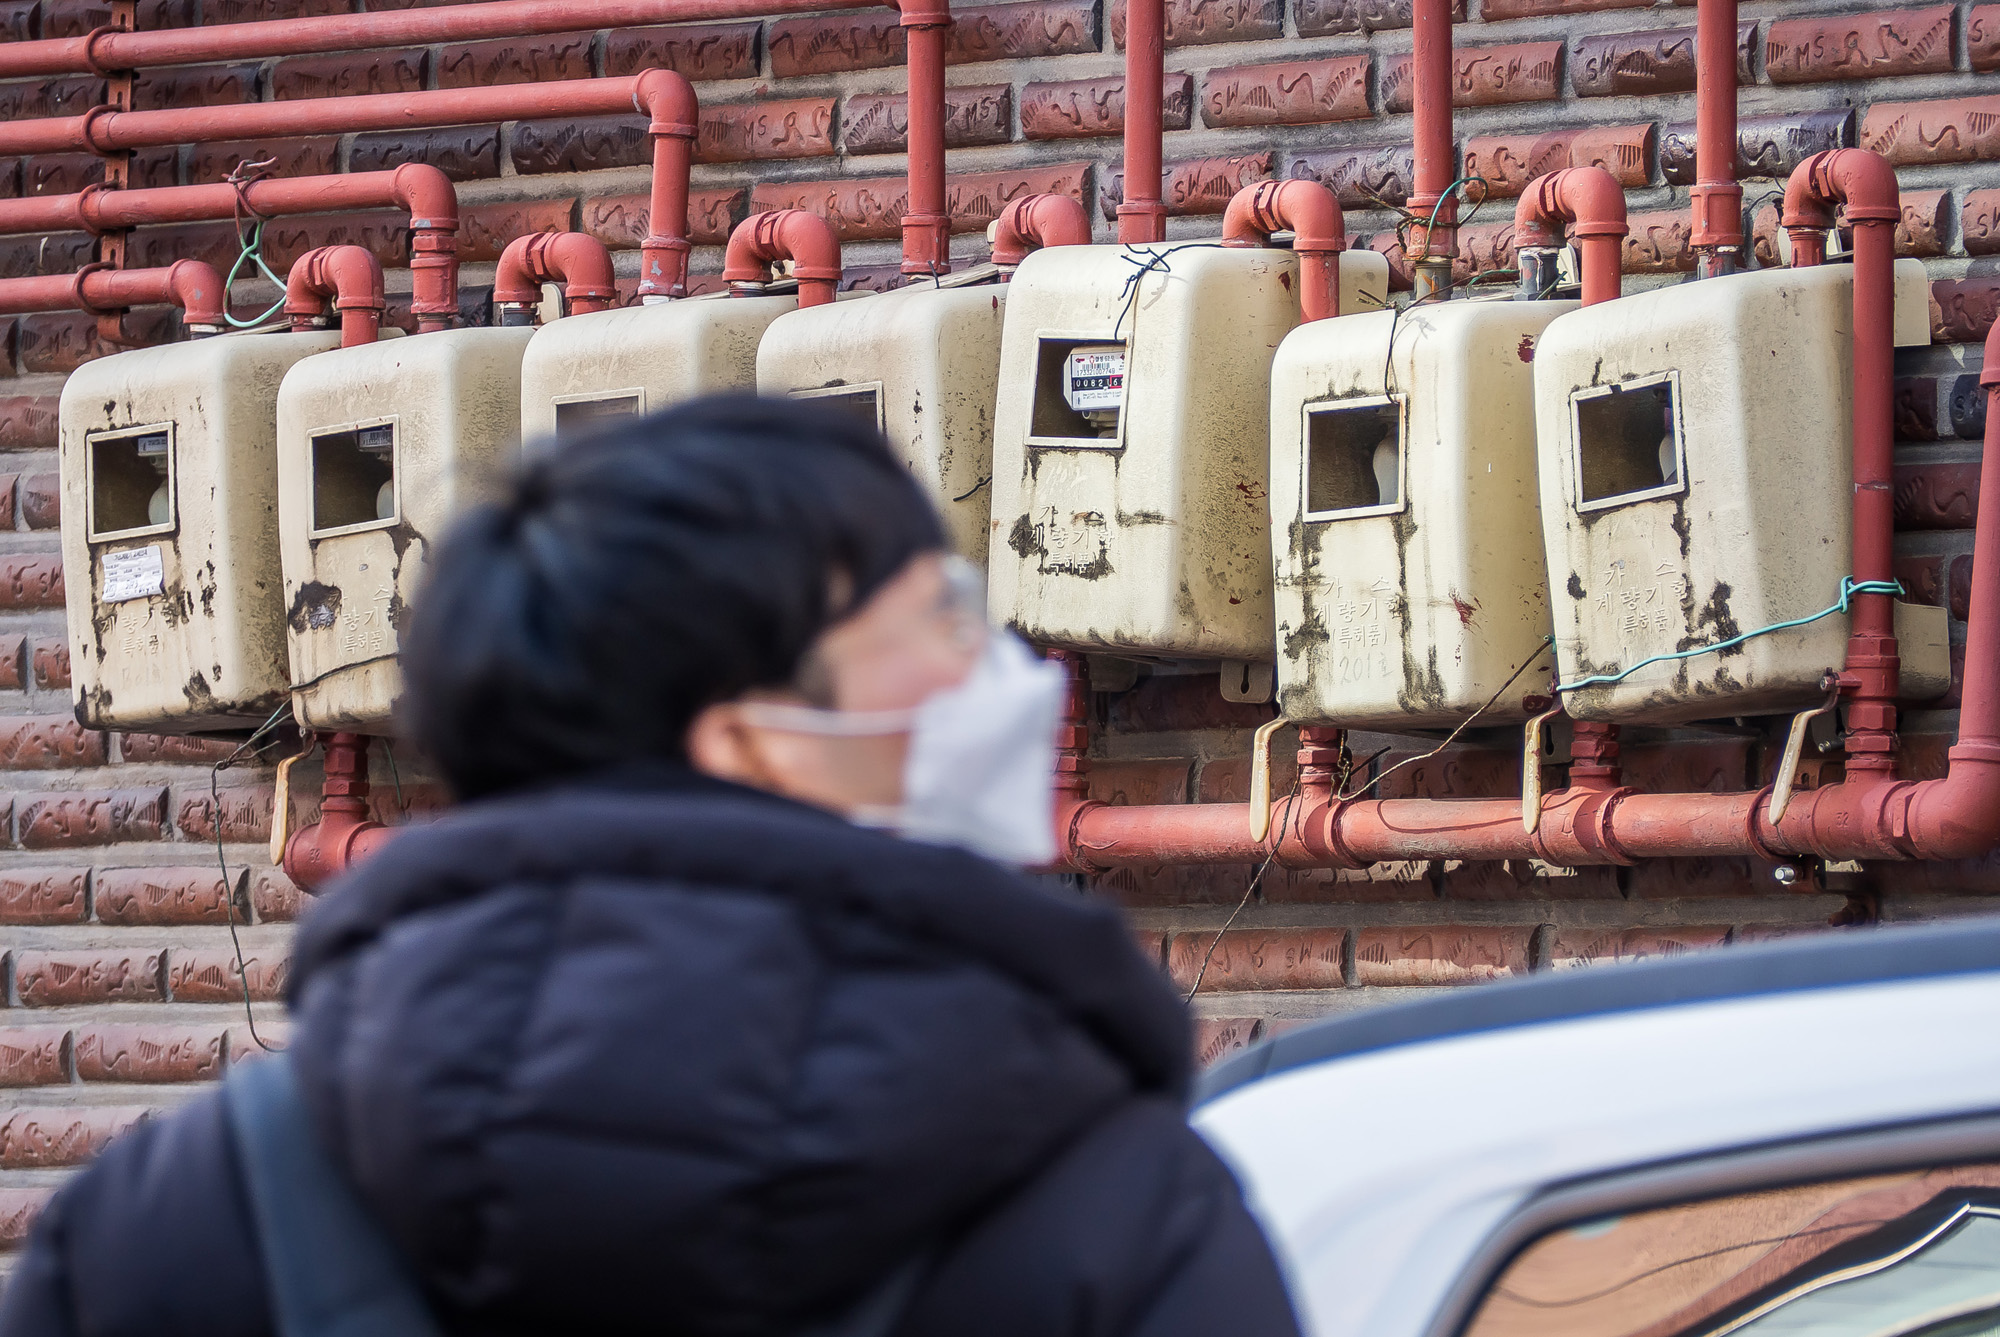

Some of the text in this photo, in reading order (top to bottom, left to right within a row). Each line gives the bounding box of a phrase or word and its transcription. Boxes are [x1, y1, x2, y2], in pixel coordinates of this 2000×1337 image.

[1493, 55, 1524, 89] SW
[1587, 44, 1616, 83] SW
[1212, 80, 1240, 116] SW
[1175, 173, 1200, 204] SW
[339, 629, 388, 657] (특허품)
[175, 881, 197, 906] MS
[82, 960, 103, 990] MS
[170, 957, 197, 989] SW
[170, 1037, 193, 1063] MS
